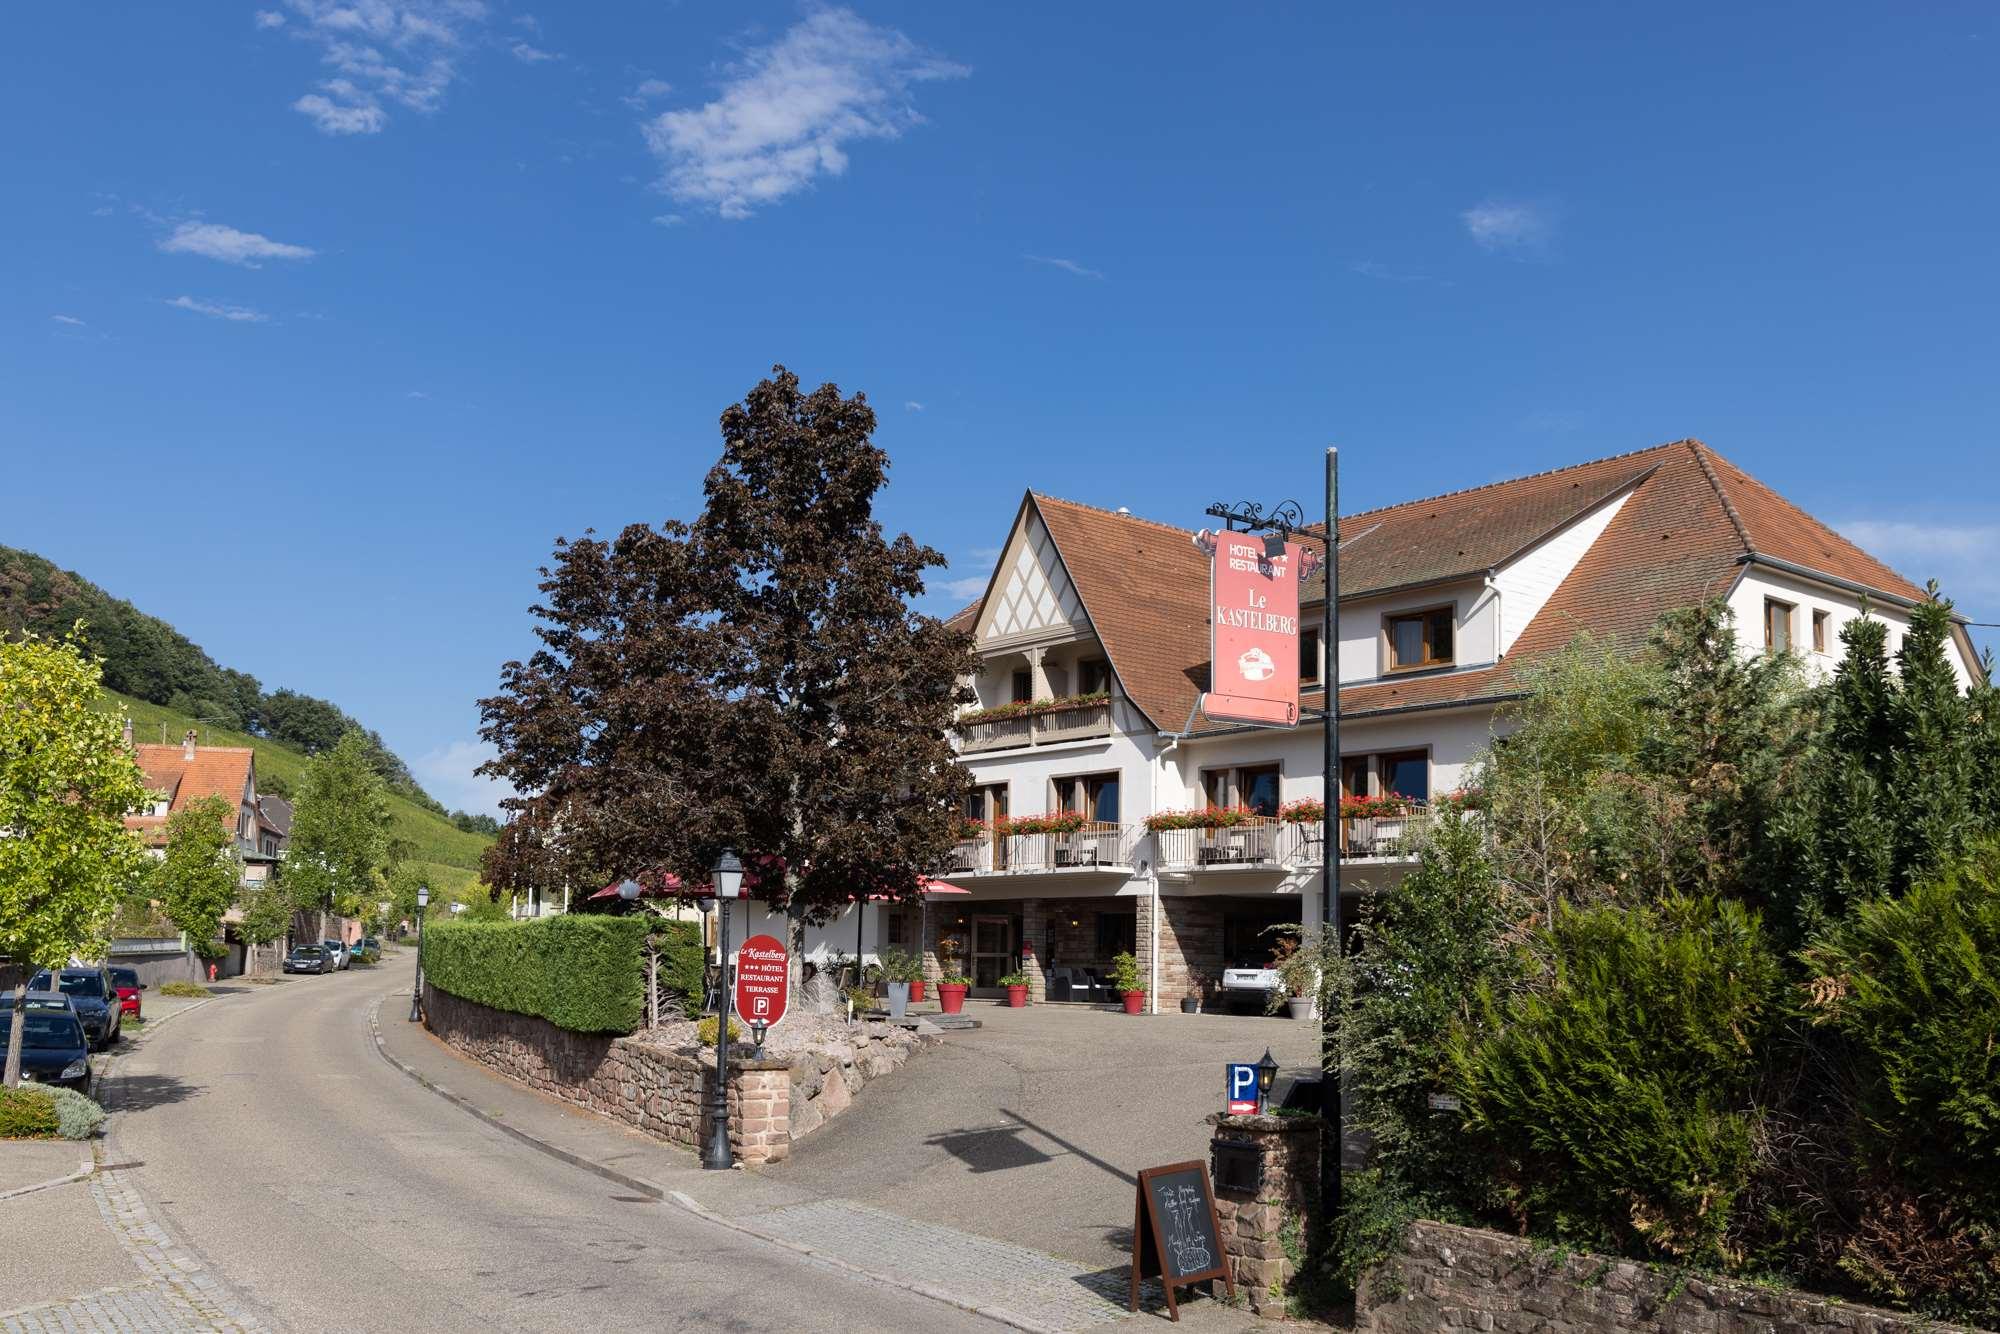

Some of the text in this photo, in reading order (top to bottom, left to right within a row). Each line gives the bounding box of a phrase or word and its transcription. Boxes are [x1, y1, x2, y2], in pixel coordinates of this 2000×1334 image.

[1229, 543, 1258, 560] HOTEL
[1229, 558, 1287, 577] RESTAURANT
[1248, 588, 1266, 609] Le
[1216, 605, 1297, 636] KASTELBERG
[748, 948, 786, 962] Kastelberg
[761, 964, 784, 973] HÔTEL
[740, 974, 784, 983] RESTAURANT
[745, 985, 779, 994] TERRASSE
[757, 999, 767, 1013] P
[1234, 1066, 1254, 1099] P
